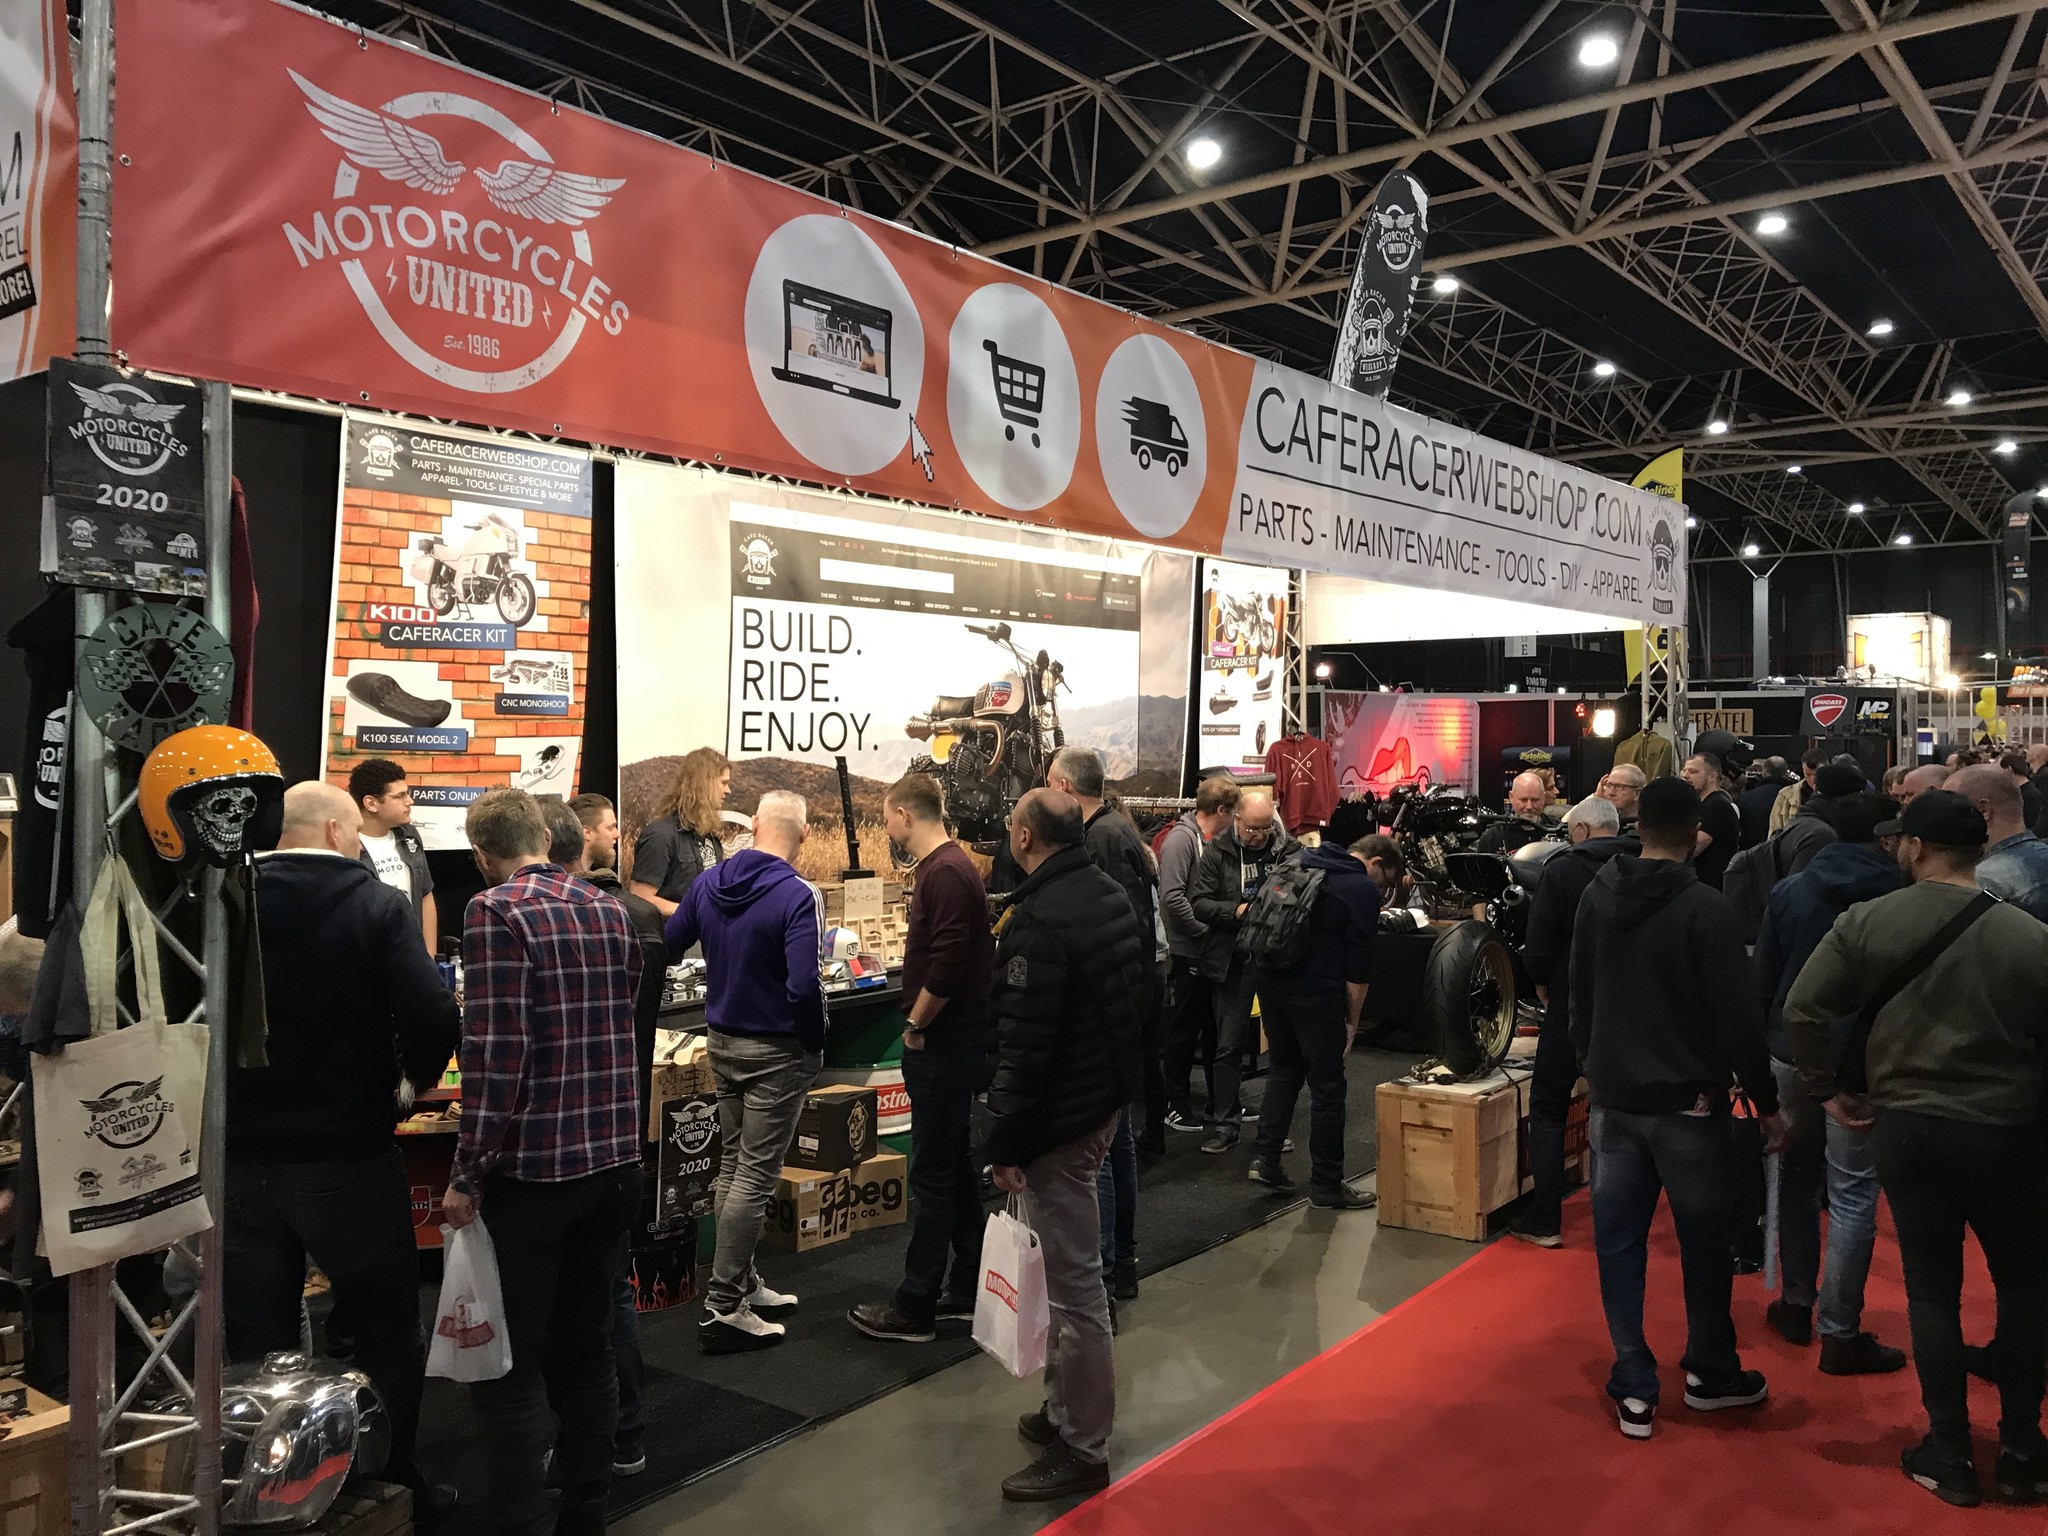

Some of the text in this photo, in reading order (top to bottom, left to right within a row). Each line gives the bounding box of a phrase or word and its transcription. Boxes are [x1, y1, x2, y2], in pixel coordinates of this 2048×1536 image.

[1376, 230, 1422, 252] MOTORCYCLES
[281, 204, 630, 336] MOTORCYCLES
[0, 269, 32, 306] ORE!
[405, 254, 534, 328] UNITED
[442, 334, 500, 360] Est. 1986
[68, 417, 189, 458] MOTORCYCLES
[106, 433, 152, 456] UNITED
[410, 436, 581, 475] CAFERACERWEBSHOP.COM
[412, 458, 441, 472] PARTS
[518, 476, 553, 490] SPECIAL
[554, 480, 579, 493] PARTS
[96, 483, 169, 513] 2020
[498, 483, 539, 498] LIFESTYLE
[540, 489, 547, 499] &
[548, 490, 573, 503] MORE
[1645, 484, 1676, 495] toline
[1239, 492, 1314, 546] PARTS
[1335, 514, 1481, 576] MAINTENANCE
[1496, 548, 1546, 587] TOOLS
[1560, 562, 1582, 592] DIY
[1591, 569, 1643, 604] APPAREL
[370, 605, 435, 623] K100
[108, 606, 210, 649] CAFE
[388, 625, 508, 643] CAFERACER KIT
[743, 607, 862, 656] BUILD.
[1210, 656, 1258, 669] CAFERACER KIT
[742, 659, 839, 703] RIDE.
[501, 698, 567, 709] CNC MONOSHOCK
[1859, 700, 1890, 715] MP
[362, 732, 458, 745] K100 SEAT MODEL 2
[740, 710, 879, 753] ENJOY.
[1519, 752, 1552, 763] Putoline
[412, 790, 482, 801] PARTS ONLIN
[84, 1101, 175, 1139] MOTORCYCLES
[111, 1114, 150, 1137] UNITED
[668, 1120, 721, 1144] MOTORCYCLES
[678, 1157, 711, 1177] 2020
